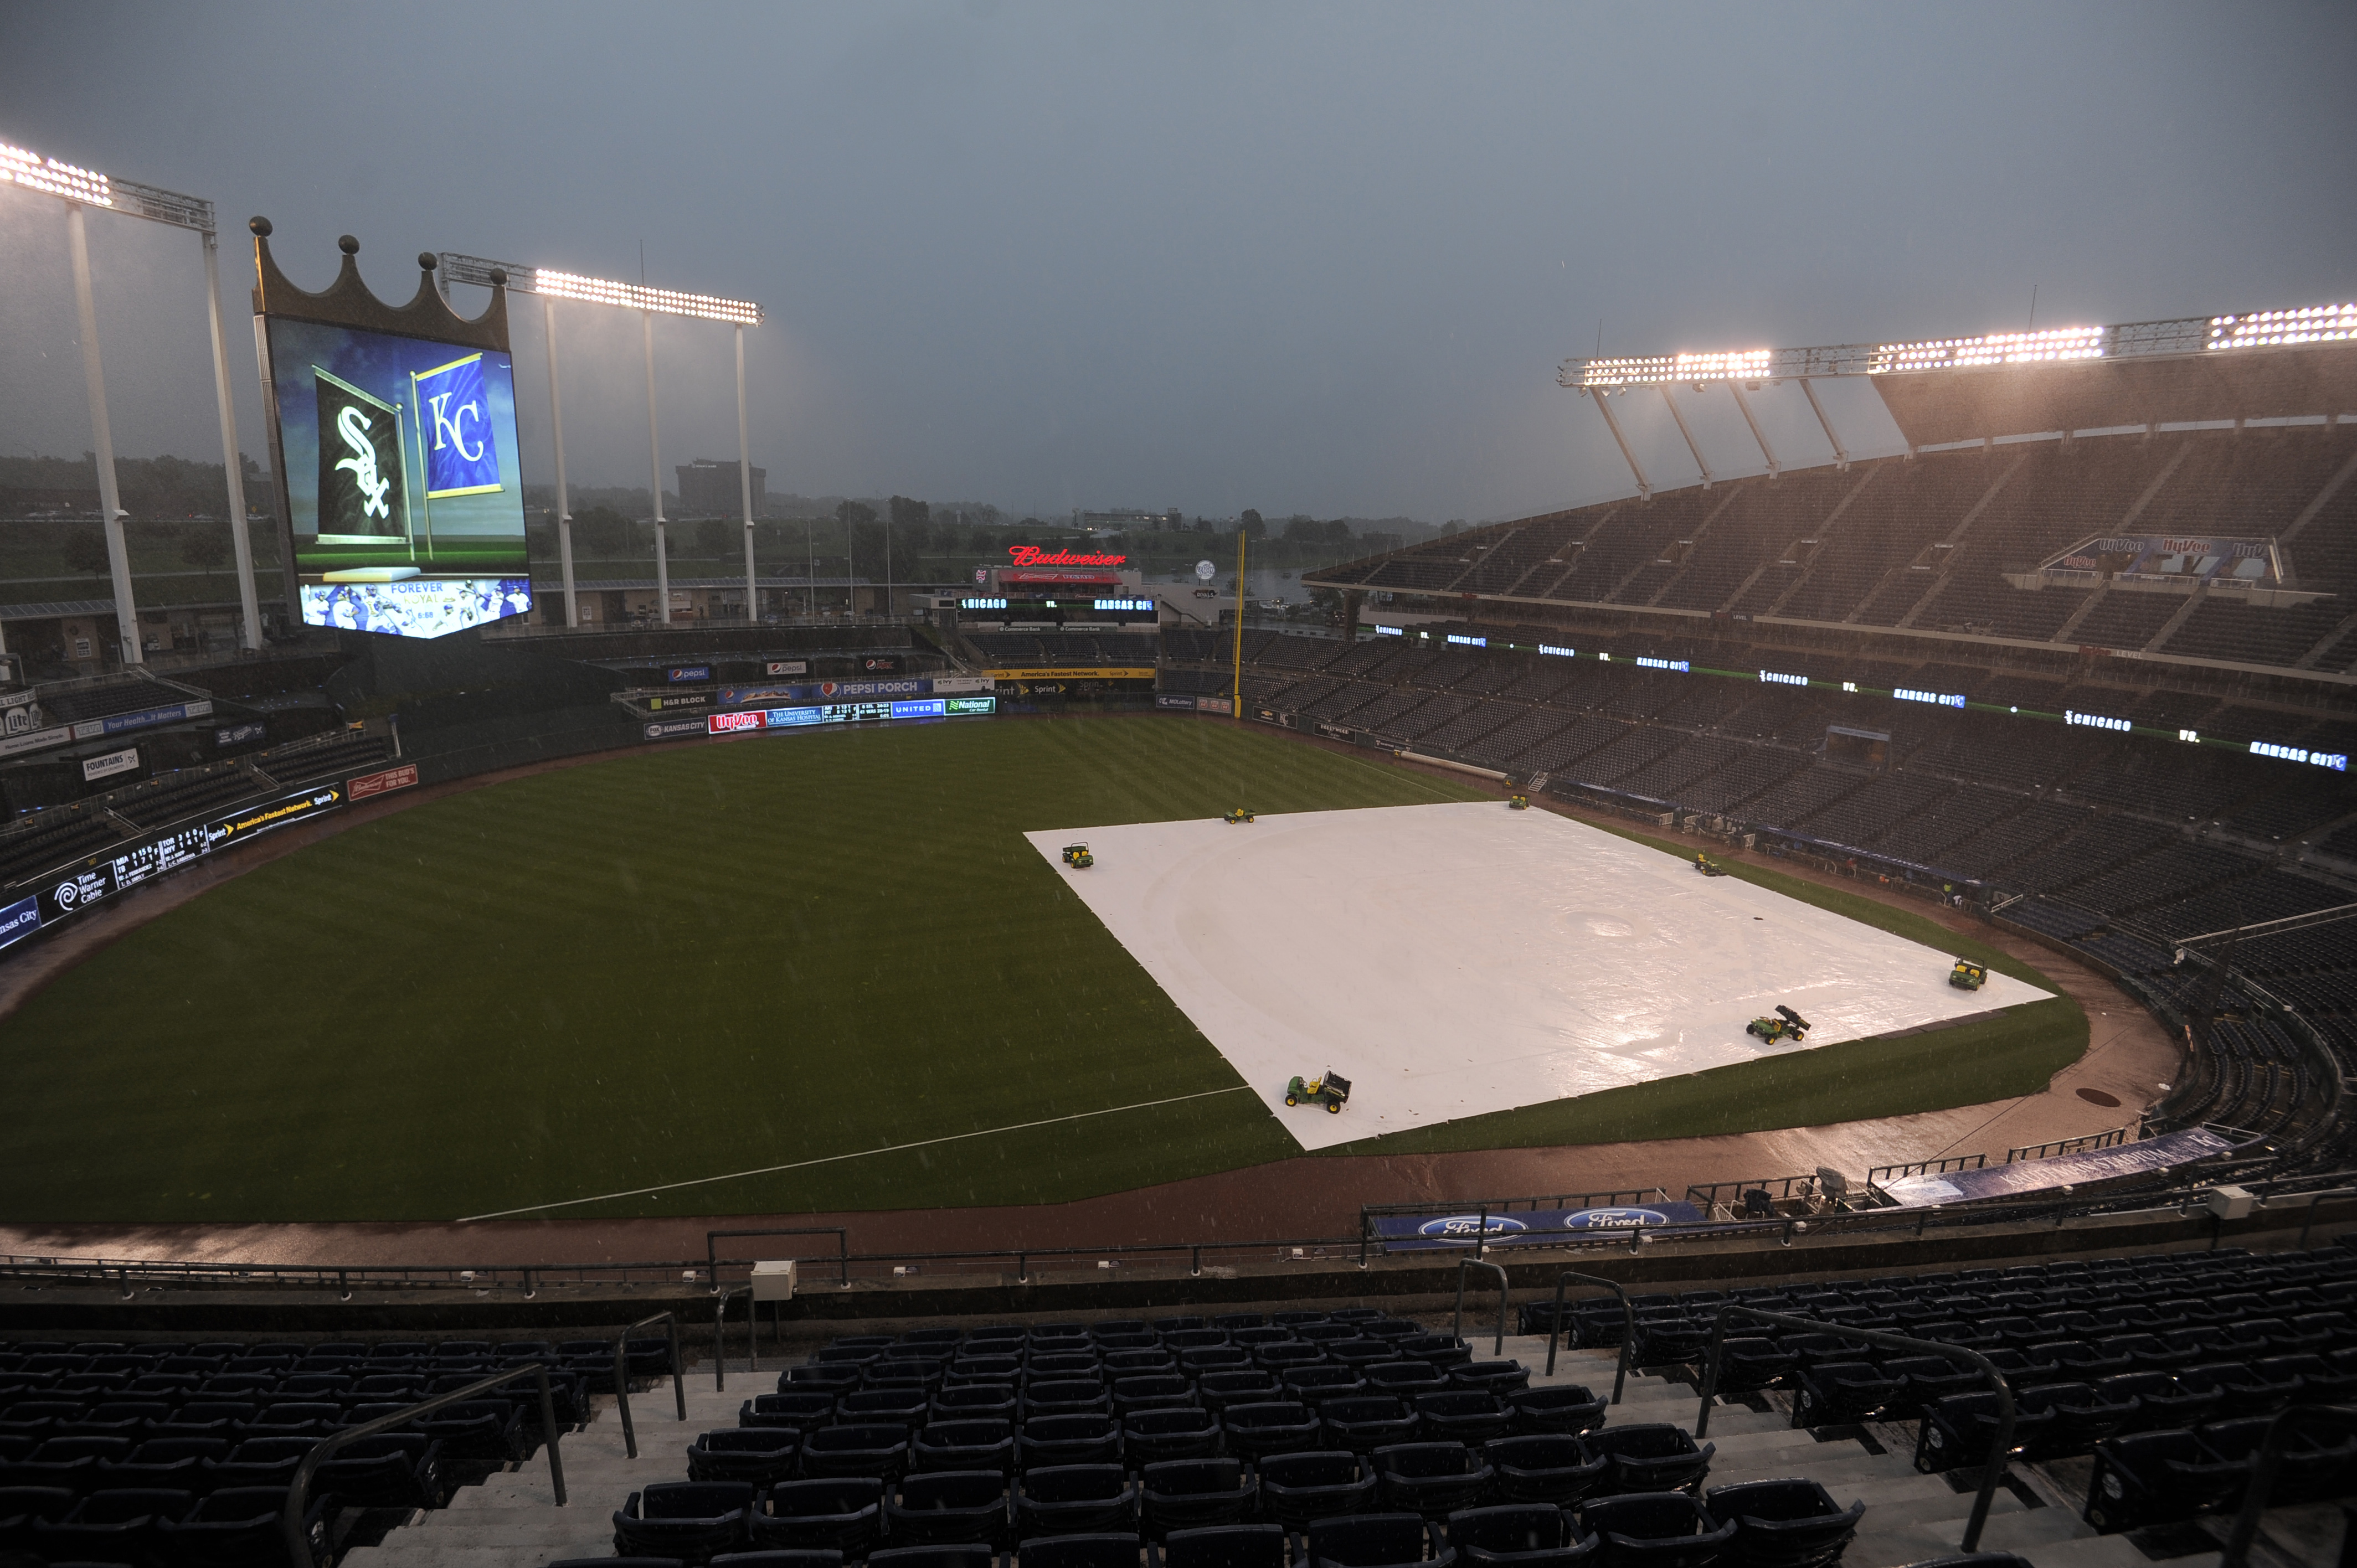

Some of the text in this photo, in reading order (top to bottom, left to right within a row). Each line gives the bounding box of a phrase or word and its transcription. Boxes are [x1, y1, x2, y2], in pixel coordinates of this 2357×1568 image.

[429, 391, 483, 462] KC
[1008, 545, 1126, 566] Budweiser
[1197, 564, 1214, 575] 360
[391, 582, 443, 594] FOREVER
[404, 594, 439, 604] ROYAL
[968, 599, 1007, 609] HICAGO
[1094, 600, 1133, 610] KANSAS
[1380, 626, 1402, 636] CHICAGO
[1448, 635, 1471, 644] KANSAS
[1543, 646, 1574, 657] CHICAGO
[1599, 653, 1610, 661] VS.
[2116, 650, 2143, 659] LEVEL
[782, 664, 802, 673] pepsi
[1636, 657, 1668, 669] KANSAS
[683, 669, 705, 679] pepsi
[1766, 672, 1808, 685] CHICAGO
[843, 682, 917, 694] PEPSI PORCH
[995, 686, 1015, 695] rint
[1035, 685, 1056, 694] Sprint
[1843, 682, 1858, 693] VS.
[7, 695, 26, 705] LIGHT
[1893, 688, 1937, 703] KANSAS
[959, 700, 990, 709] National
[8, 714, 27, 731] Lite
[107, 720, 122, 730] Your
[157, 710, 181, 720] Matters
[2074, 713, 2131, 731] CHICAGO
[78, 724, 102, 735] TEVA
[664, 724, 689, 733] KANSAS
[690, 722, 705, 730] CITY
[2179, 729, 2200, 743] VS.
[2250, 741, 2308, 762] KANSAS
[86, 755, 123, 771] FOUNTAINS
[385, 767, 415, 780] THIS BUD'S
[314, 794, 332, 805] Sprint
[264, 808, 286, 821] Fastest
[286, 800, 312, 813] Network.
[208, 828, 226, 842] Sprint
[162, 837, 175, 847] TOR
[164, 844, 176, 854] NYY
[116, 855, 129, 866] MIA
[118, 865, 126, 874] TB
[77, 872, 96, 885] Time
[79, 878, 106, 894] Warner
[81, 889, 102, 904] Cable
[0, 910, 37, 935] nsas City
[2187, 1134, 2226, 1148] KC
[1999, 1148, 2173, 1186] KAUFFMAN STADIUM
